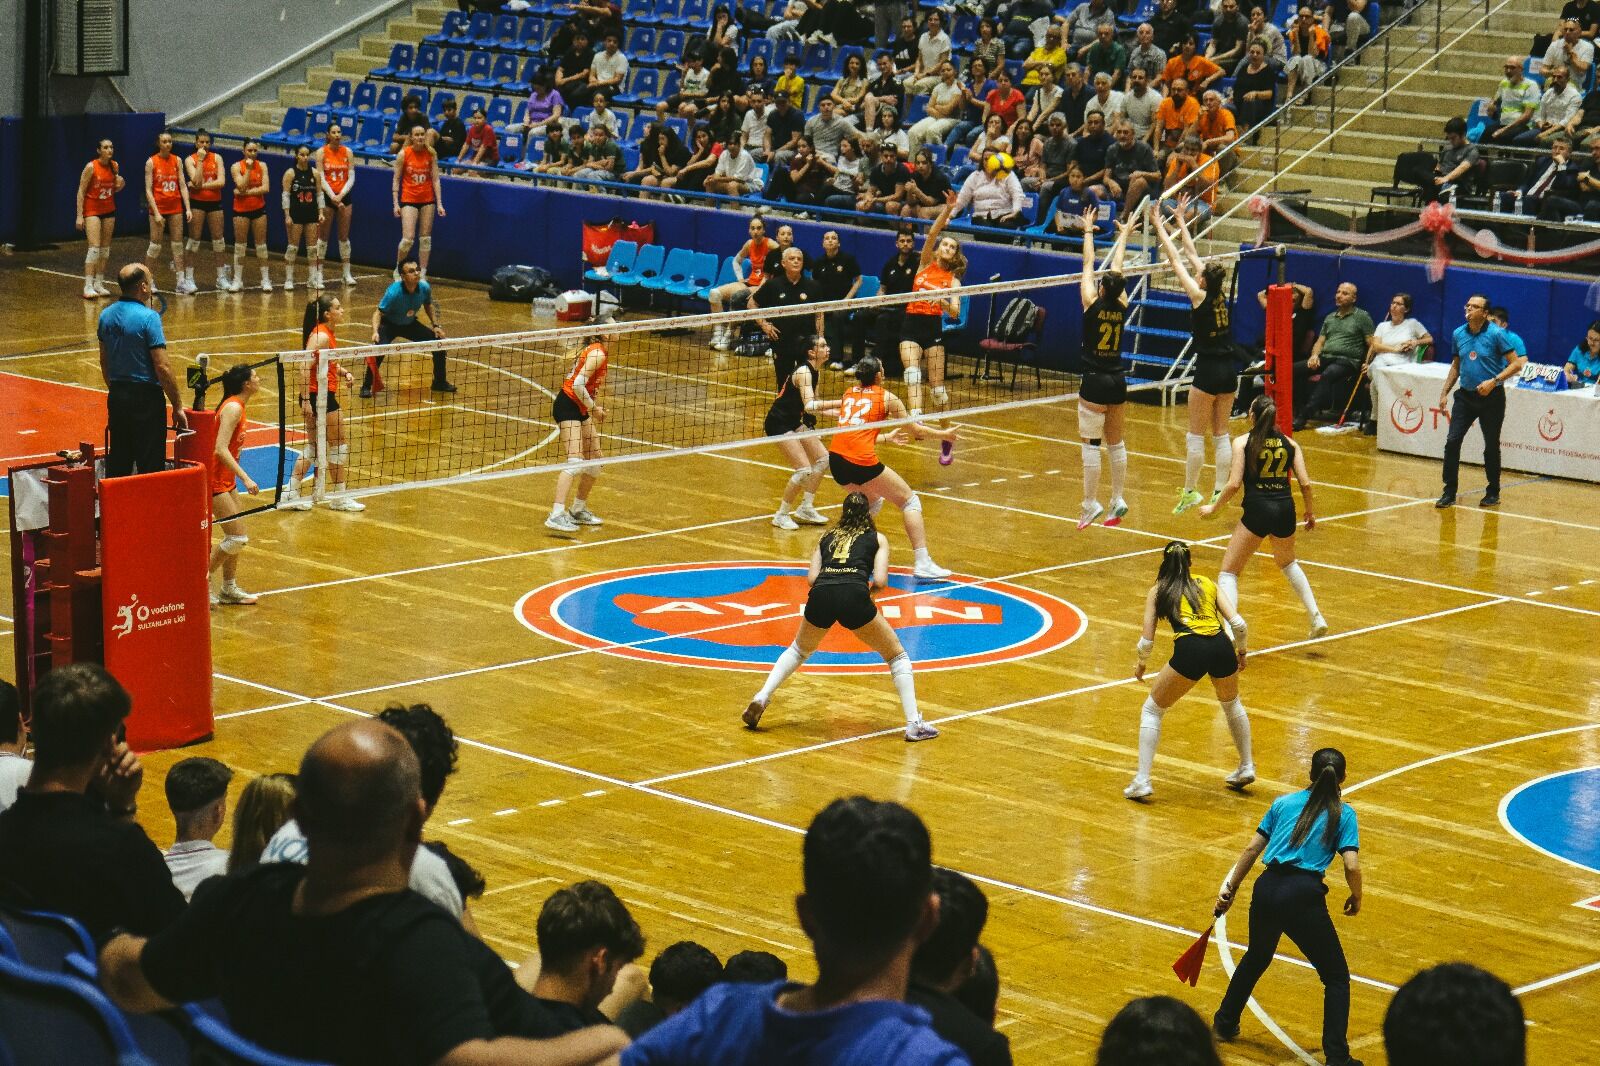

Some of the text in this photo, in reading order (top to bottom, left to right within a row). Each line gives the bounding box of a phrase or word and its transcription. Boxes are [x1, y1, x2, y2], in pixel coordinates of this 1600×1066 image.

[411, 173, 426, 185] 30
[1097, 322, 1122, 351] 21
[1259, 447, 1288, 478] 22
[150, 602, 185, 615] vodafone
[640, 601, 984, 620] AYIN
[137, 619, 172, 630] SULTANLAR
